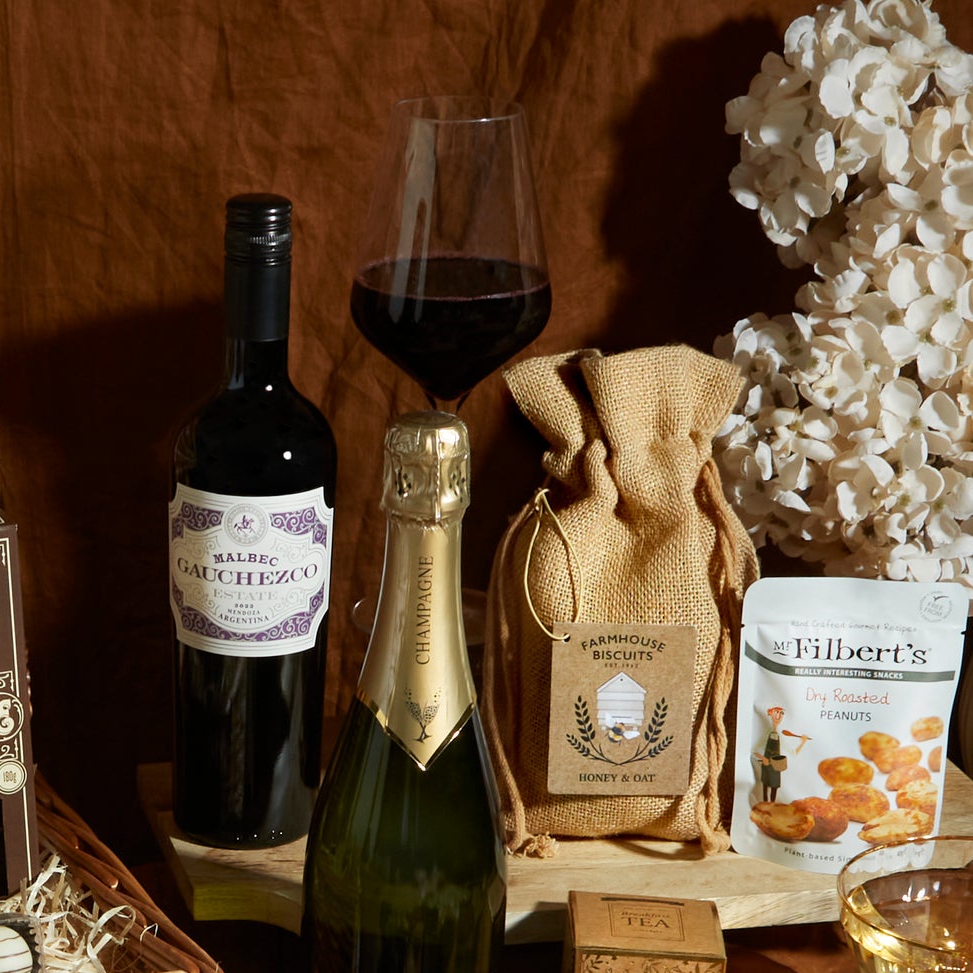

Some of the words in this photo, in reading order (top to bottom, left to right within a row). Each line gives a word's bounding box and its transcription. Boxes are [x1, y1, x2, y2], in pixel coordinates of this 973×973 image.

[213, 552, 279, 567] MALBEC
[177, 557, 318, 585] GAUCHEZCO
[213, 588, 278, 600] ESTATE
[227, 608, 261, 616] MENDOZA
[415, 555, 433, 665] CHAMPAGNE
[218, 613, 270, 624] ARGENTINA
[581, 634, 666, 653] FARMHOUSE
[592, 650, 653, 661] BISCUITS
[793, 638, 927, 665] Filbert's
[795, 667, 822, 675] REALLY
[823, 668, 872, 678] INTERESTING
[873, 671, 903, 680] SNACKS
[806, 687, 827, 708] Dry
[833, 688, 890, 705] Roasted
[820, 710, 872, 722] PEANUTS
[579, 773, 618, 783] HONEY
[621, 773, 630, 783] &
[633, 774, 656, 783] OAT
[622, 917, 670, 928] TEA
